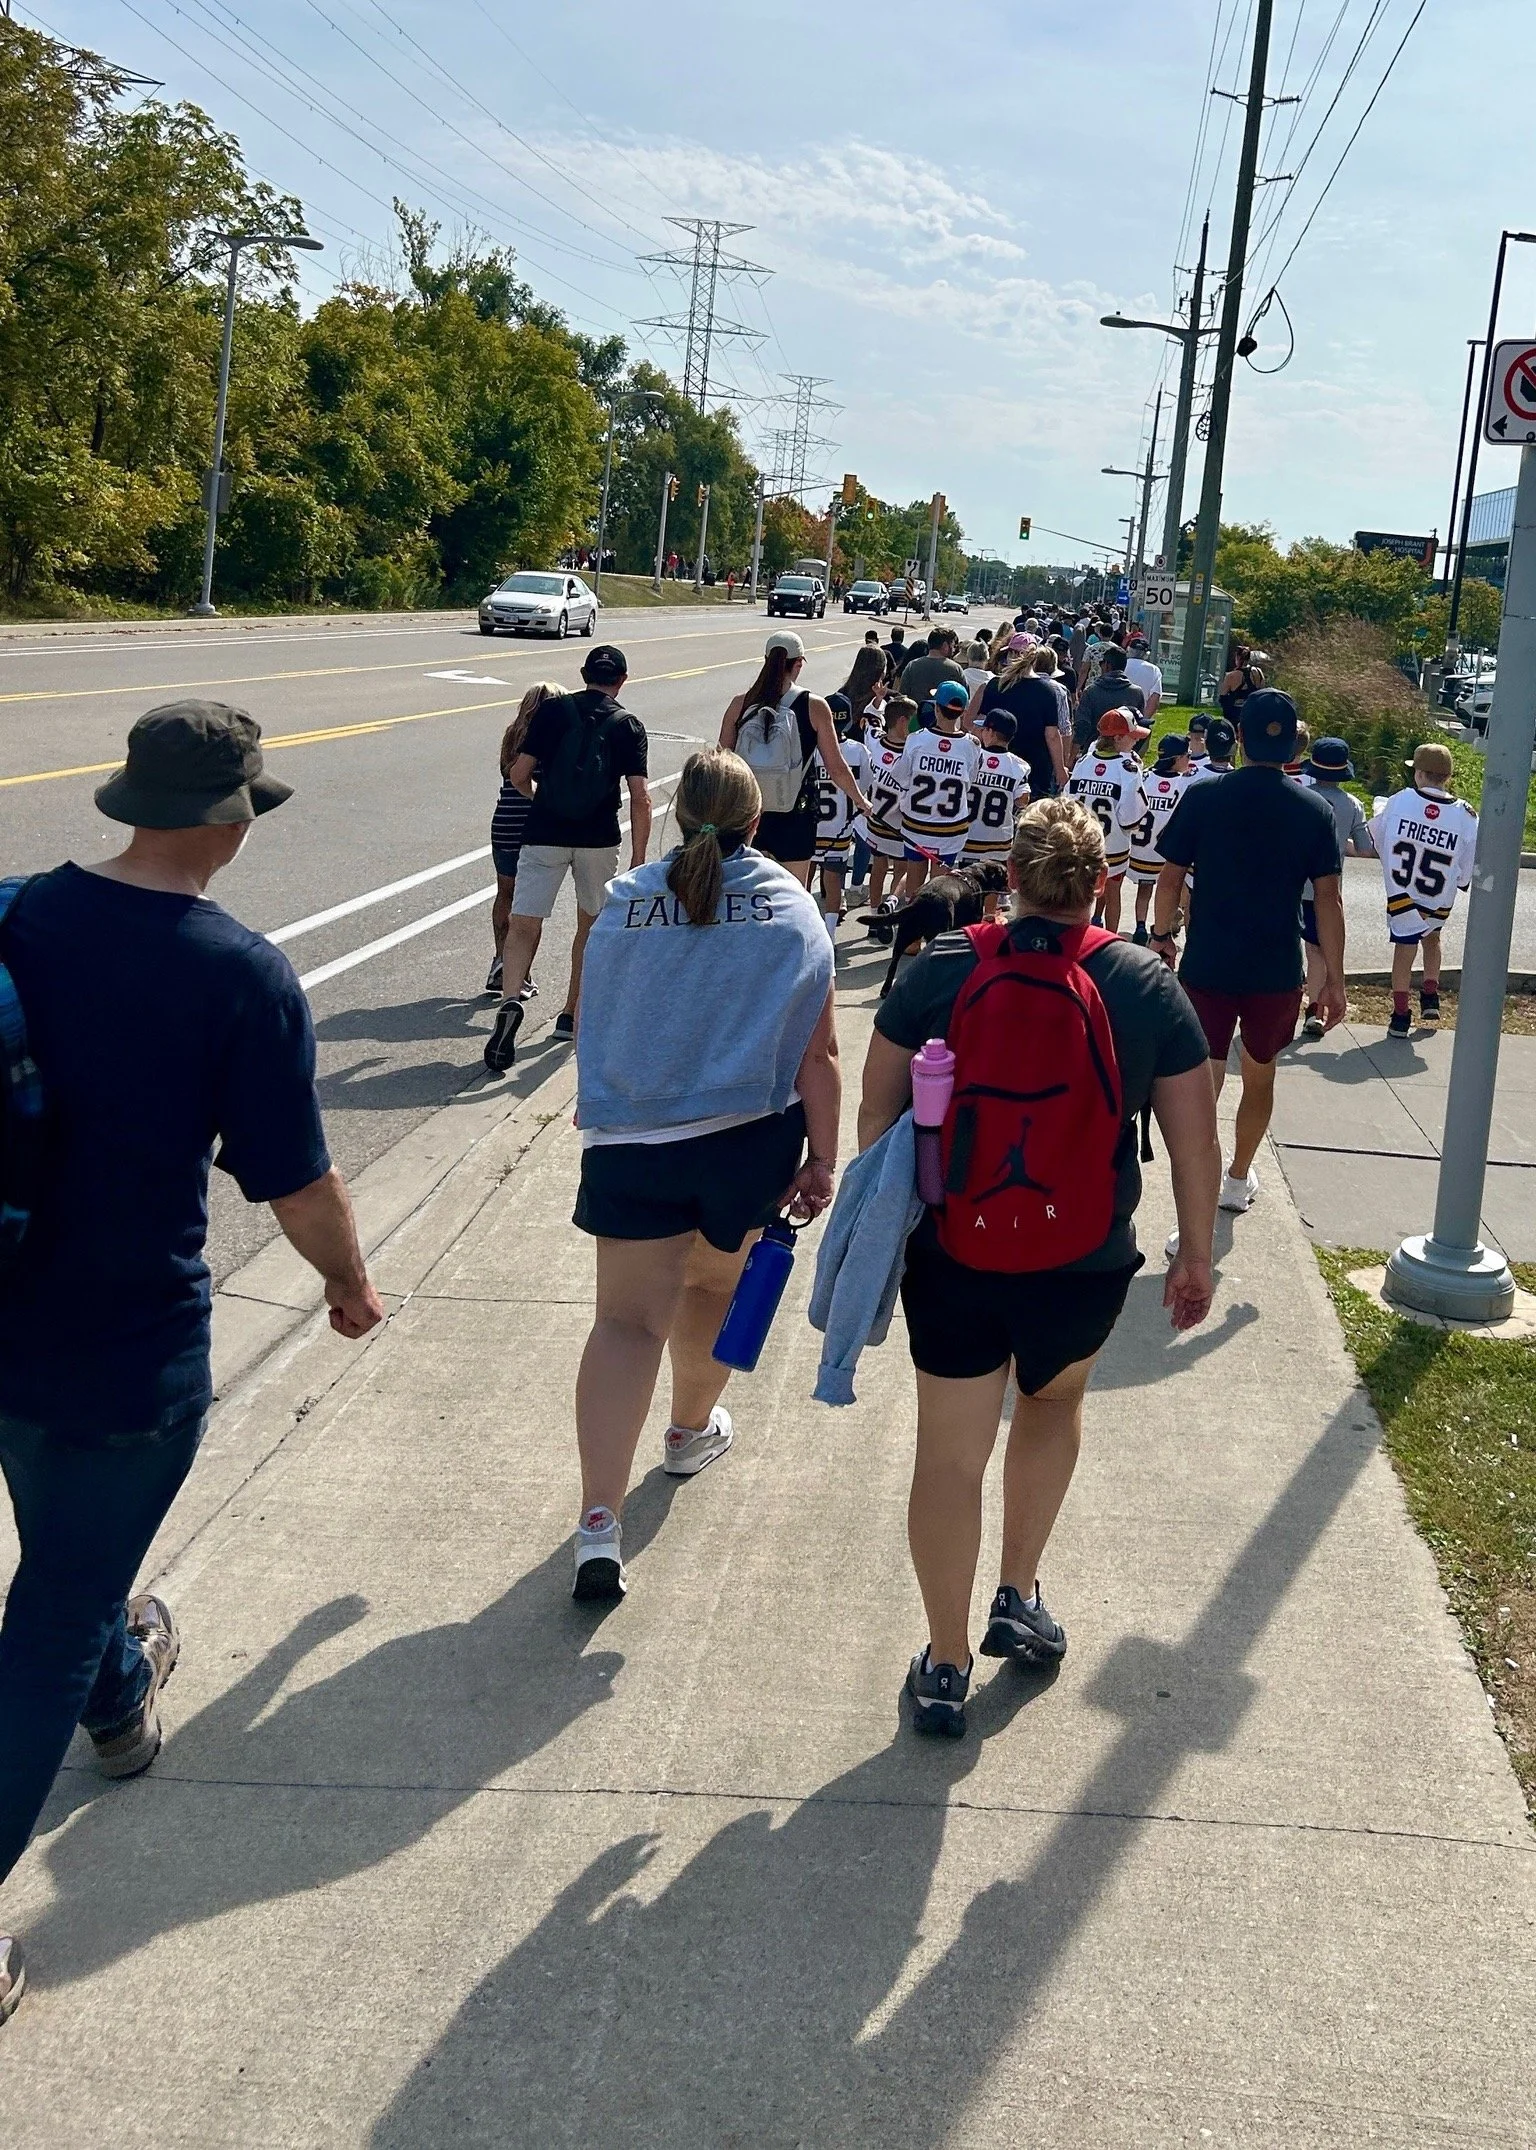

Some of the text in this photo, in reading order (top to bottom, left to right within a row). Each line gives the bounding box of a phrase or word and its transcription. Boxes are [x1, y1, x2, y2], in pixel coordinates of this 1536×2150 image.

[1120, 578, 1130, 590] H
[1146, 587, 1173, 606] 50
[920, 756, 964, 776] CROMIE
[911, 774, 963, 817] 23
[1077, 780, 1114, 796] CARTER
[1398, 819, 1458, 851] FRIESEN
[1392, 841, 1453, 897] 35
